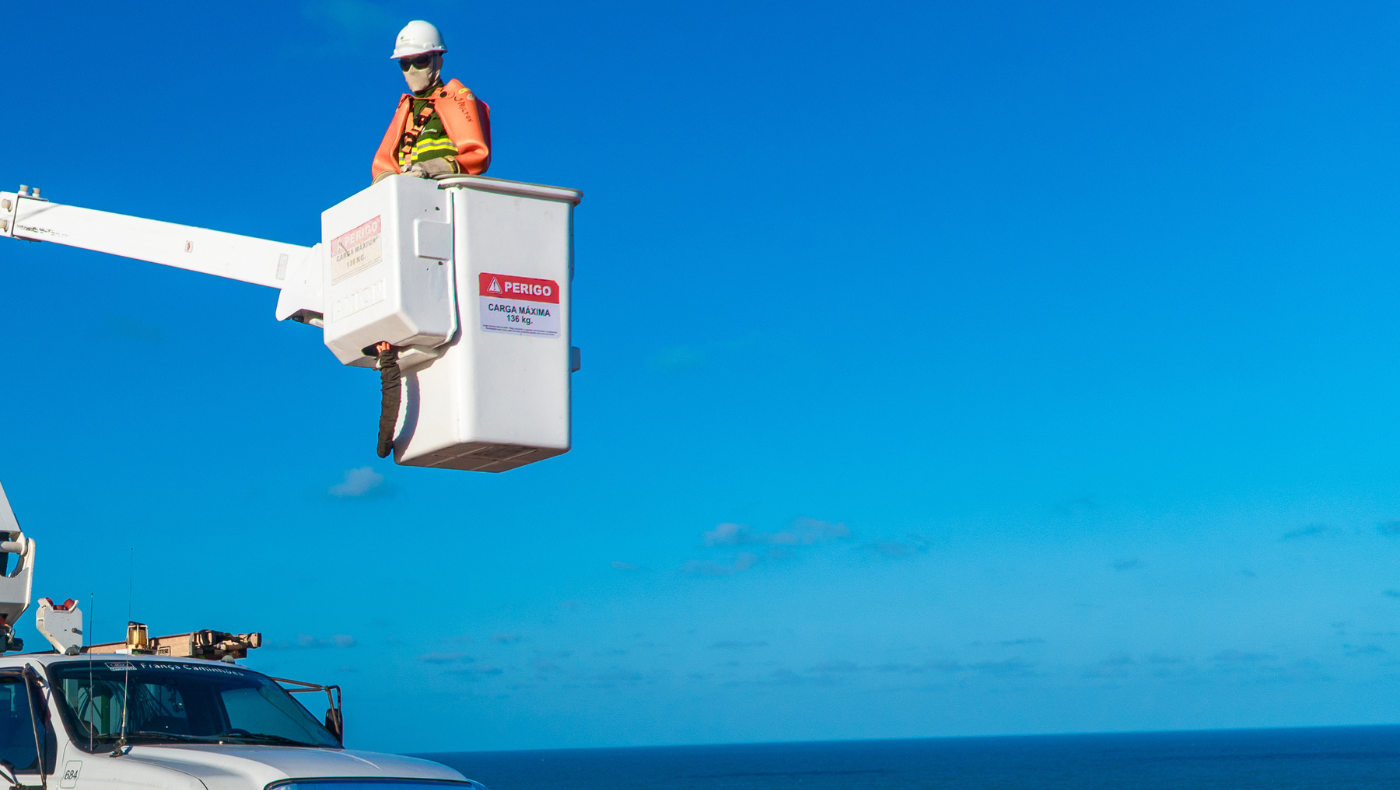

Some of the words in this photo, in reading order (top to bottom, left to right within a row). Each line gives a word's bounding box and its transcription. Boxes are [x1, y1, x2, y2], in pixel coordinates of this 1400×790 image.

[344, 221, 378, 247] PERIGO
[504, 281, 552, 297] PERIGO
[488, 303, 517, 314] CARGA
[518, 305, 551, 317] MÁXIMA
[506, 314, 520, 323] 136
[521, 315, 534, 326] kg.
[140, 662, 181, 671] França
[64, 769, 79, 780] 684
